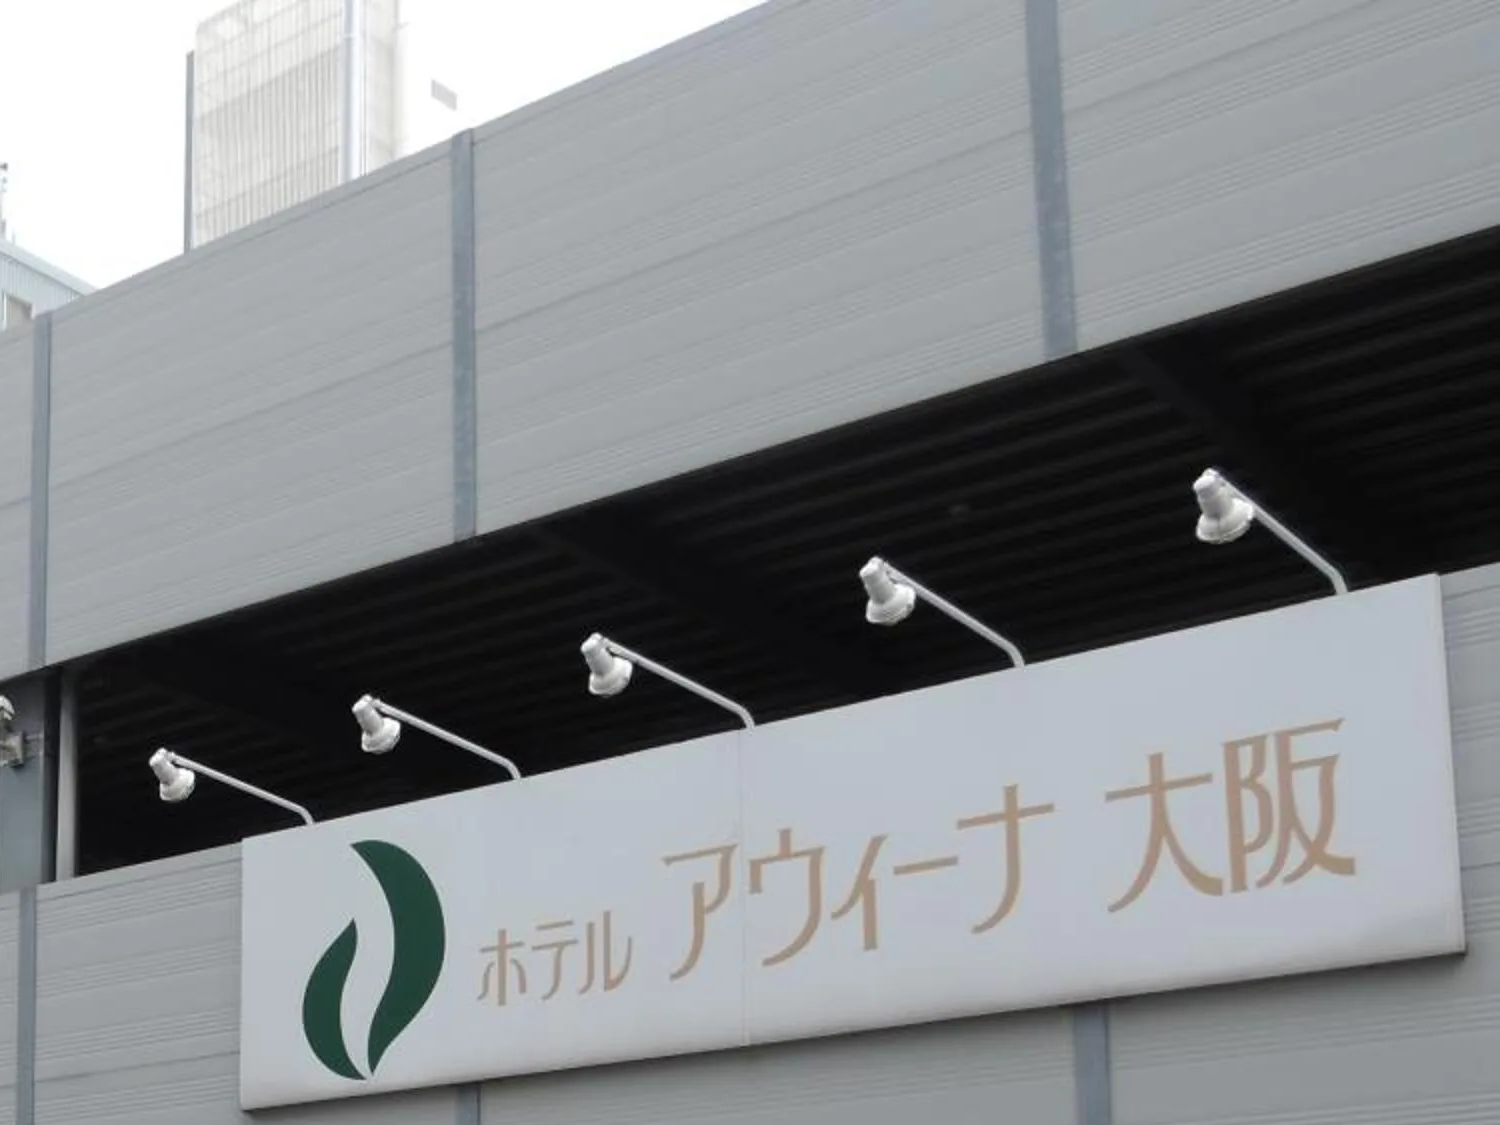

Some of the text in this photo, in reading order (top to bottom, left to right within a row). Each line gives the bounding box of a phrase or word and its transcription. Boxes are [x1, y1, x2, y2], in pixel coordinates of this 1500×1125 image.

[476, 716, 1358, 1007] ホテル アウィーナ 大阪
